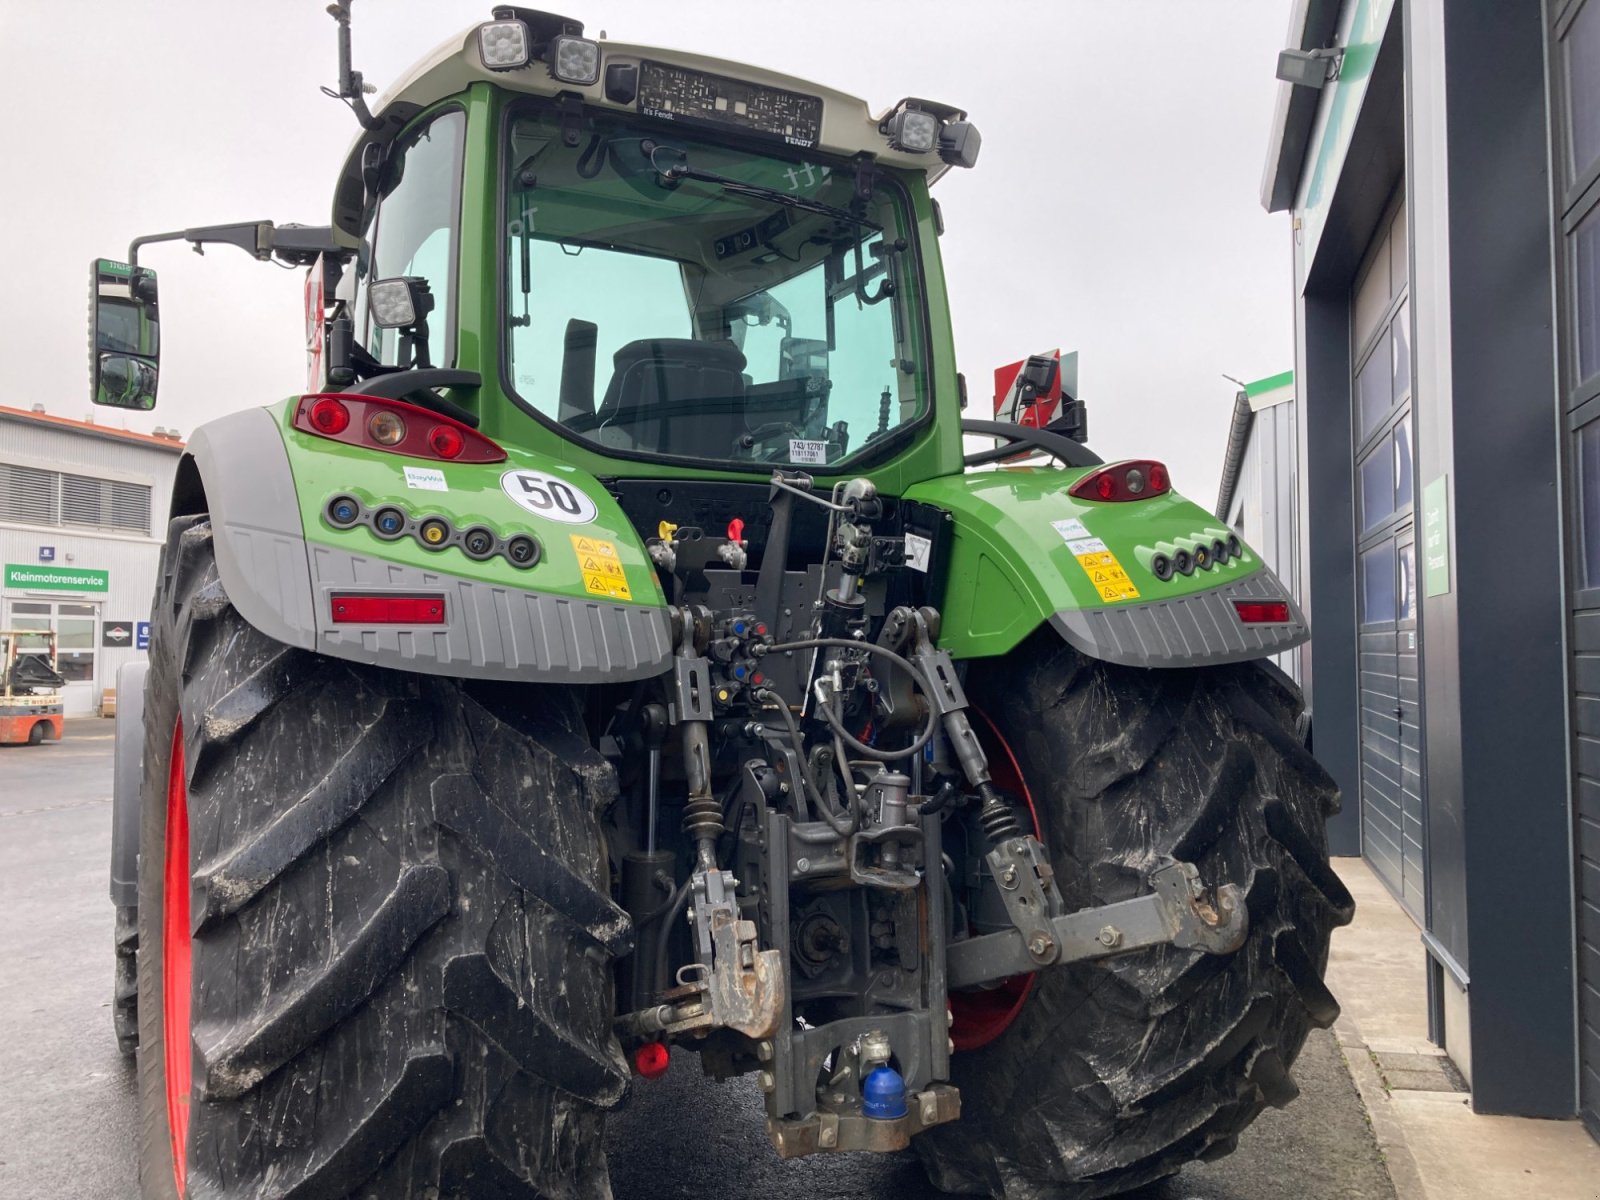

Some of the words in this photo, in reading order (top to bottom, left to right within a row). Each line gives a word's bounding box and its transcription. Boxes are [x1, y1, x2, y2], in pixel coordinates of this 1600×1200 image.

[643, 107, 653, 116] It's
[784, 135, 814, 148] FENDT
[515, 474, 582, 515] 50
[10, 571, 104, 586] Kleinmotorenservice
